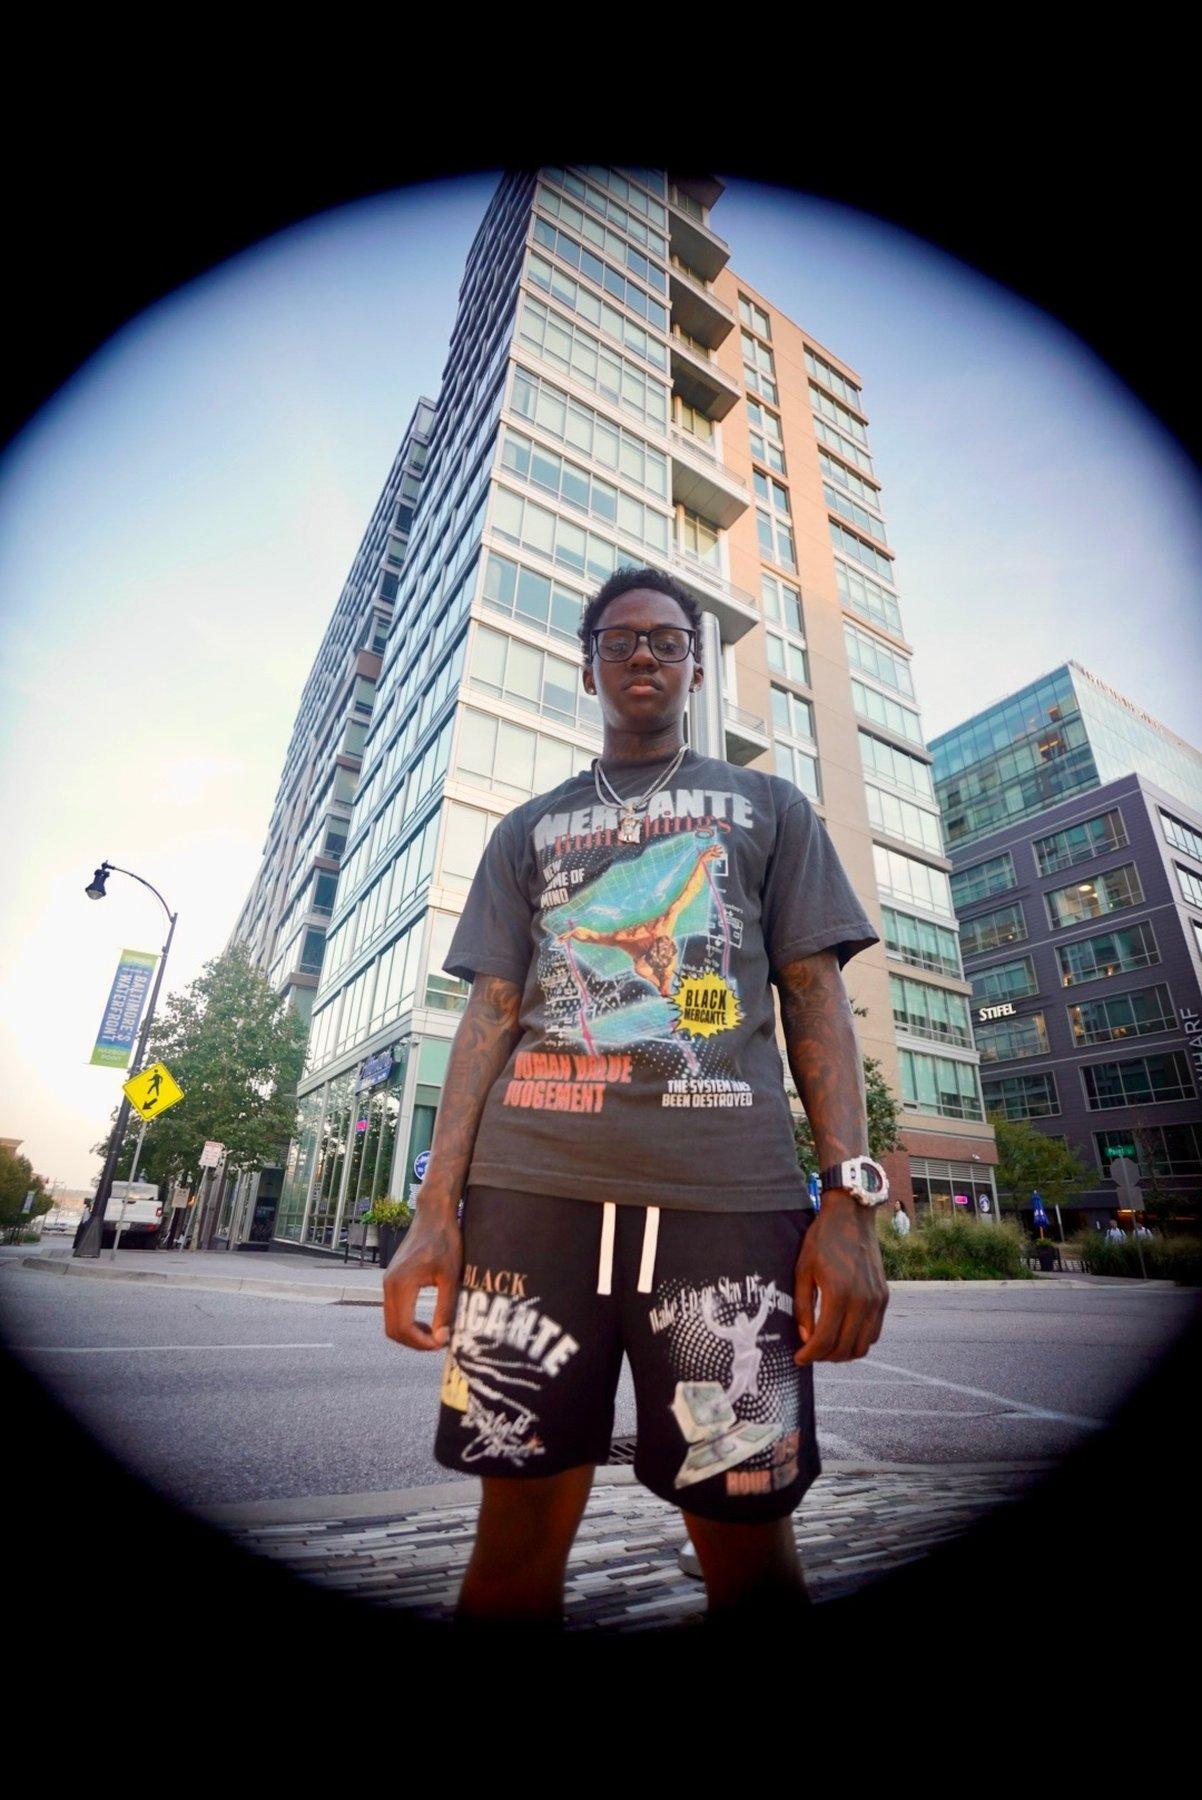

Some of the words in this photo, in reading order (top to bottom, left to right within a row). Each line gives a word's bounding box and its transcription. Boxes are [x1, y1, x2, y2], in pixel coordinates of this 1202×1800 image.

[570, 867, 585, 884] OF
[541, 888, 569, 908] MIND
[102, 974, 132, 1042] WATERFRONT
[116, 974, 147, 1043] BALTIMORE'S
[685, 988, 727, 1010] BLACK
[684, 1009, 727, 1025] MERCANTE
[979, 1003, 1016, 1022] STIFEL
[574, 1054, 633, 1084] VALUE
[668, 1079, 687, 1093] THE
[690, 1079, 731, 1093] SYSTEM
[662, 1093, 691, 1107] BEEN
[692, 1092, 753, 1107] DESTROYED
[463, 1264, 527, 1297] BLACK
